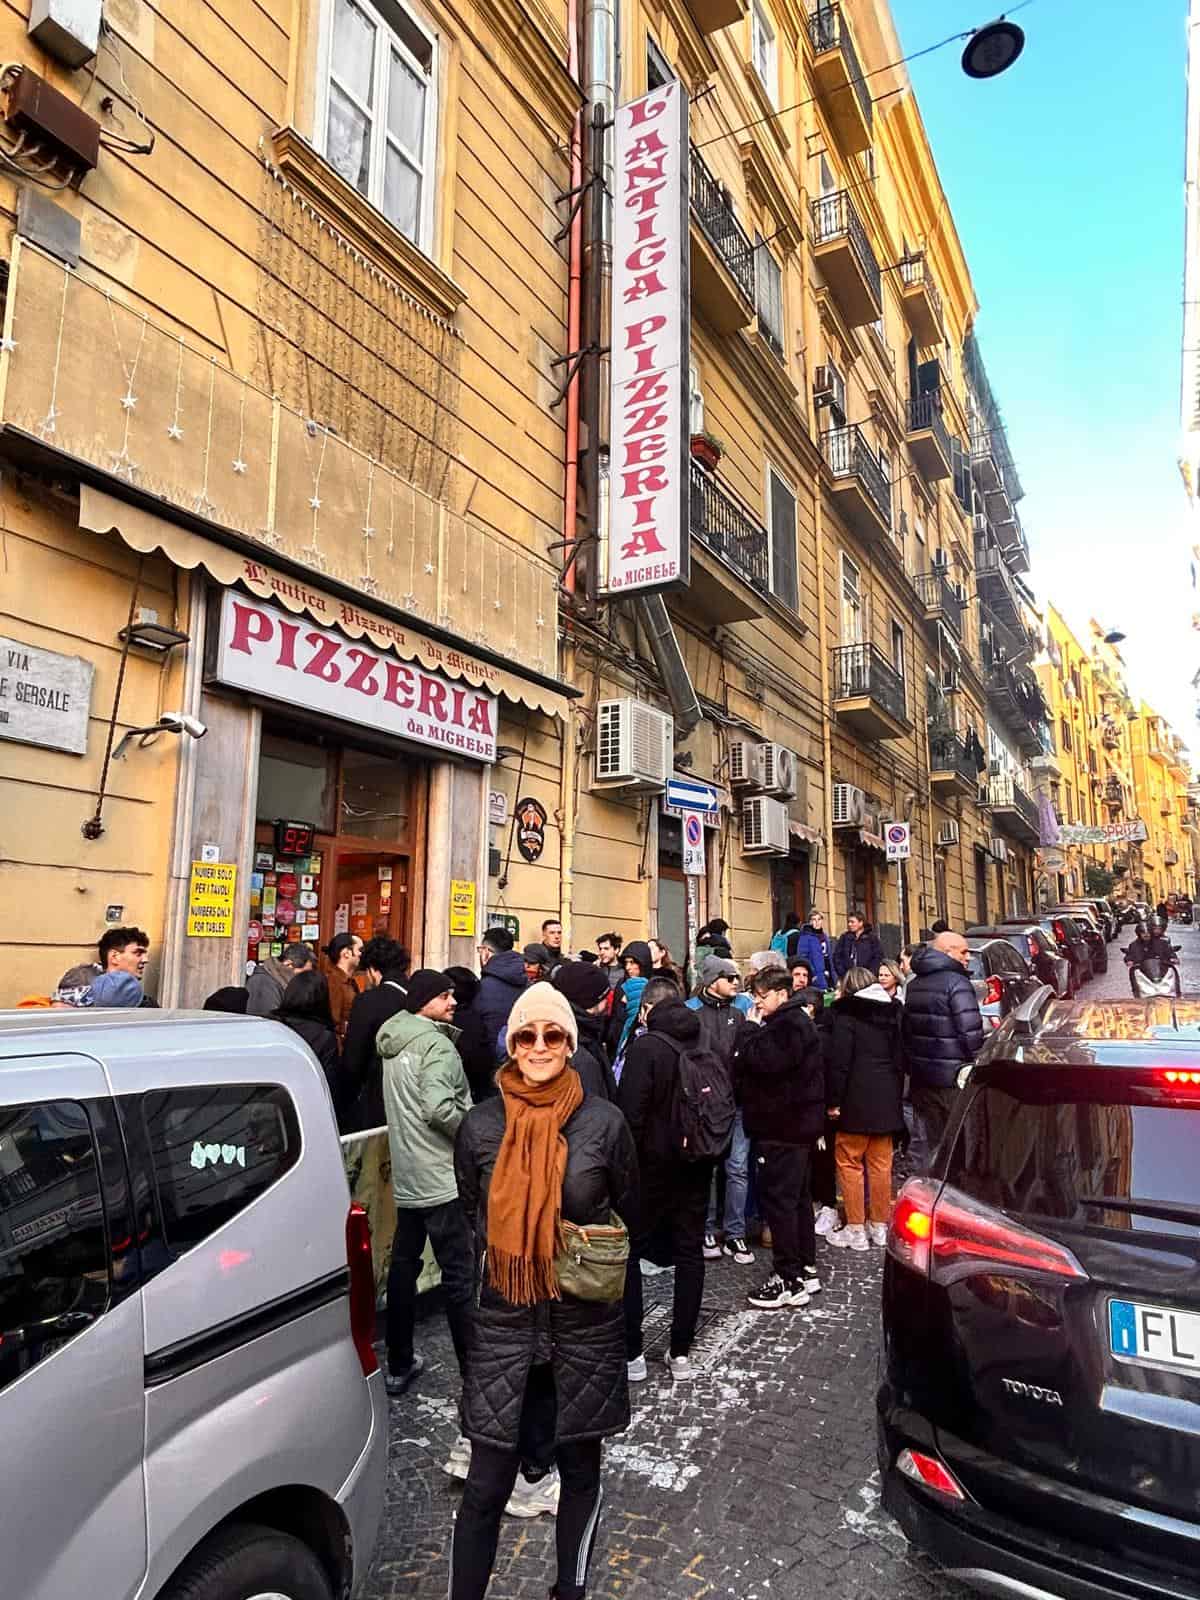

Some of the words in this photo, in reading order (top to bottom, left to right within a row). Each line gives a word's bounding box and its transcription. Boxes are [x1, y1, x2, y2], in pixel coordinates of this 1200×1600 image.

[624, 86, 674, 304] L'ANTICA
[621, 315, 669, 560] PIZZERIA
[611, 574, 623, 588] da
[624, 561, 677, 586] MICHELE
[340, 603, 406, 645] Pizzeria
[8, 650, 29, 671] VIA
[230, 601, 494, 737] PIZZERIA
[16, 681, 70, 712] SERSALE
[407, 718, 424, 735] da
[429, 724, 494, 757] MICHELE
[284, 829, 309, 853] 92
[195, 868, 216, 879] NUMERI
[217, 869, 233, 880] SOLO
[195, 883, 206, 894] PER
[211, 883, 230, 896] TAVOLI
[191, 906, 217, 917] NUMBERS
[217, 907, 231, 918] ONLY
[193, 921, 205, 932] FOR
[206, 922, 226, 933] TABLES
[1141, 1311, 1195, 1361] FL
[1002, 1378, 1064, 1407] TOYOTA
